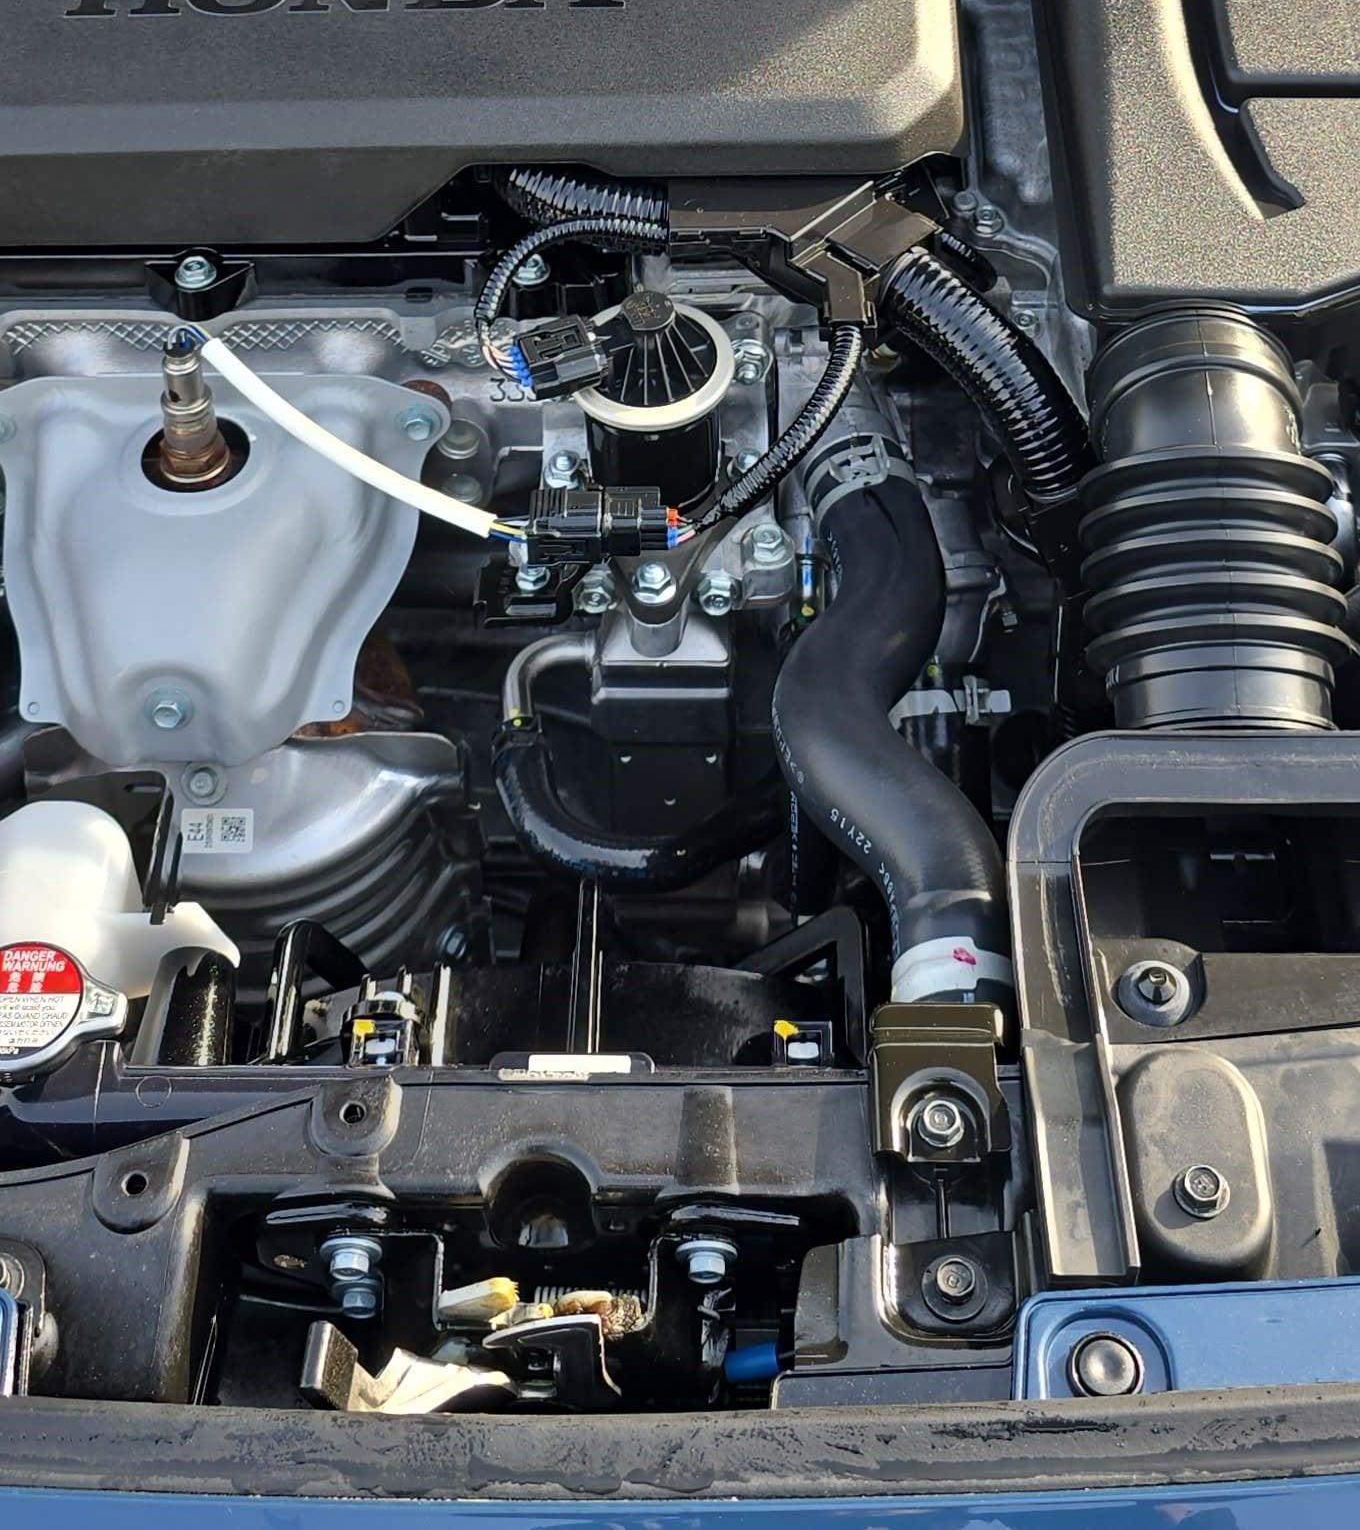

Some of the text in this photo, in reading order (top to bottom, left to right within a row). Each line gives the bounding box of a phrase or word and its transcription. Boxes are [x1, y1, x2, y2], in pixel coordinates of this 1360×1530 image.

[187, 822, 204, 841] E44
[829, 808, 872, 854] 22Y15
[3, 950, 57, 962] DANGER
[2, 960, 66, 973] WARNUNG
